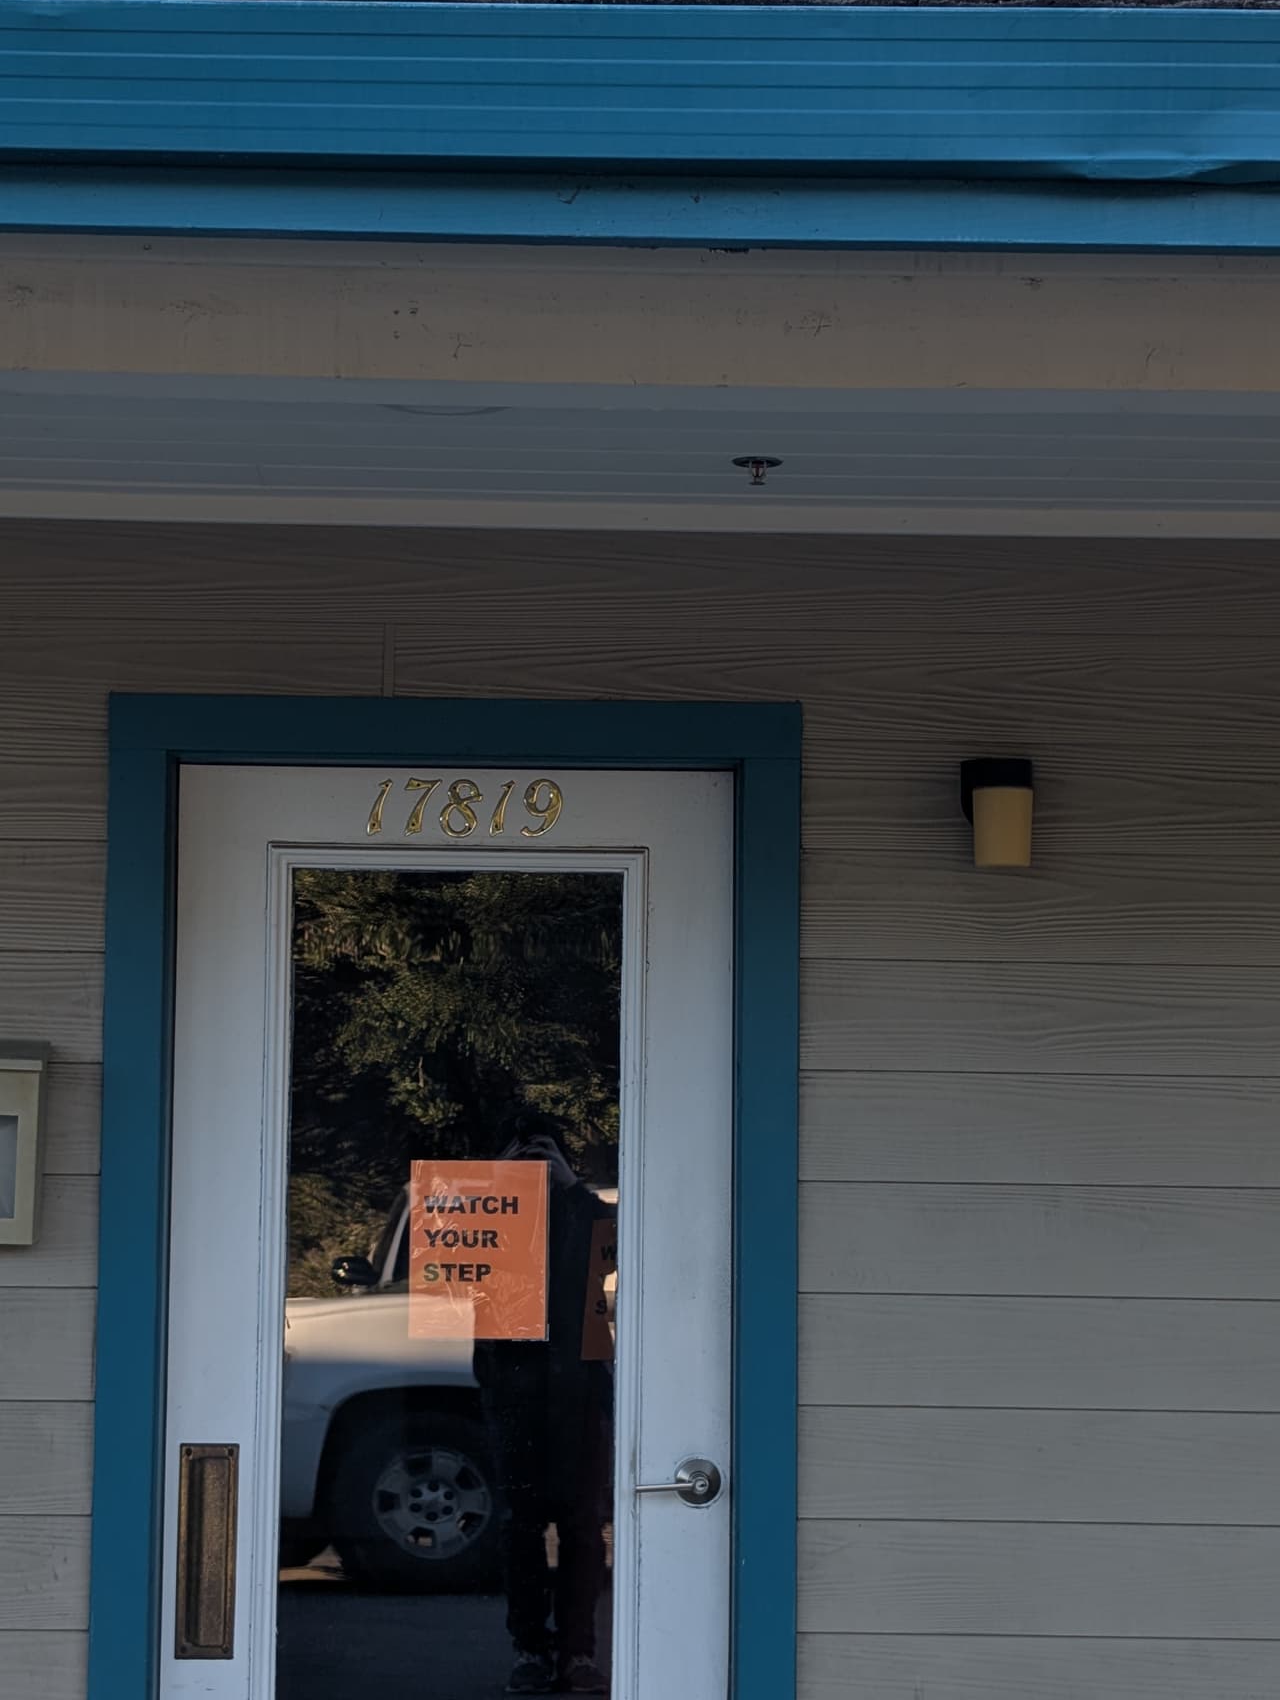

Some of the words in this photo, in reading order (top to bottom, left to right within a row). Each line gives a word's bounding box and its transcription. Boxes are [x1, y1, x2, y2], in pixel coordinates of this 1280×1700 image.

[366, 777, 564, 839] 17819
[423, 1195, 519, 1215] WATCH
[423, 1228, 500, 1249] YOUR
[422, 1262, 492, 1283] STEP
